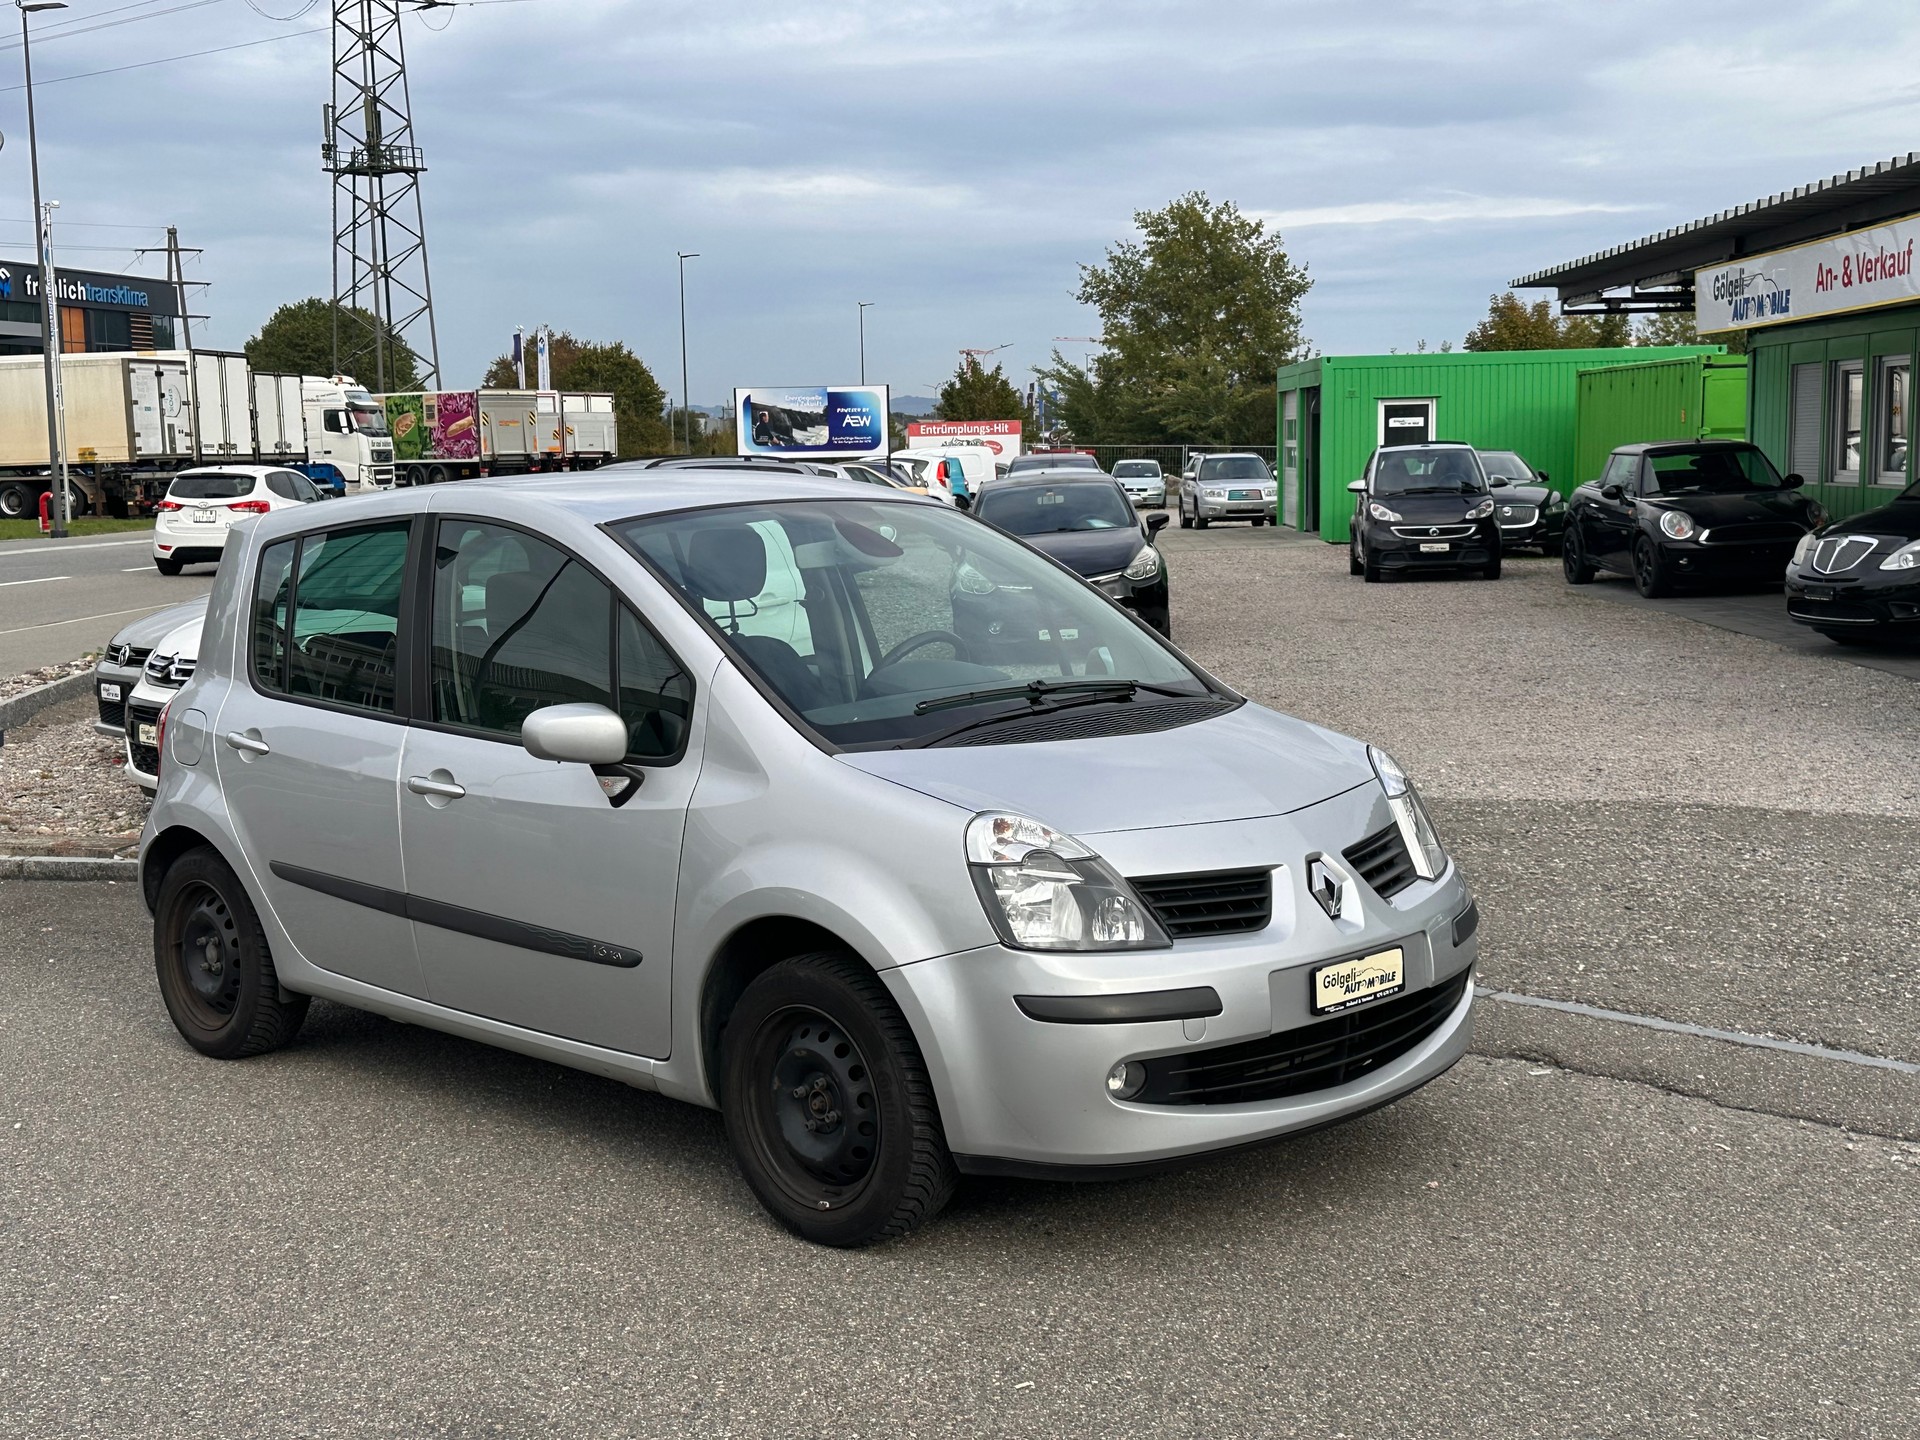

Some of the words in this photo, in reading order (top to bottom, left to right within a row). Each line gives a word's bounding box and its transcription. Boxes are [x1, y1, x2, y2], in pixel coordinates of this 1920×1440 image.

[1815, 262, 1838, 293] An-
[1841, 255, 1853, 287] &
[1856, 238, 1913, 284] Verkauf
[25, 274, 149, 307] frlichtransklima
[1713, 267, 1745, 306] Gölgeli
[842, 414, 871, 427] AEW
[920, 423, 1009, 436] Entrümplungs-Hit
[1323, 967, 1357, 989] Gölgeli
